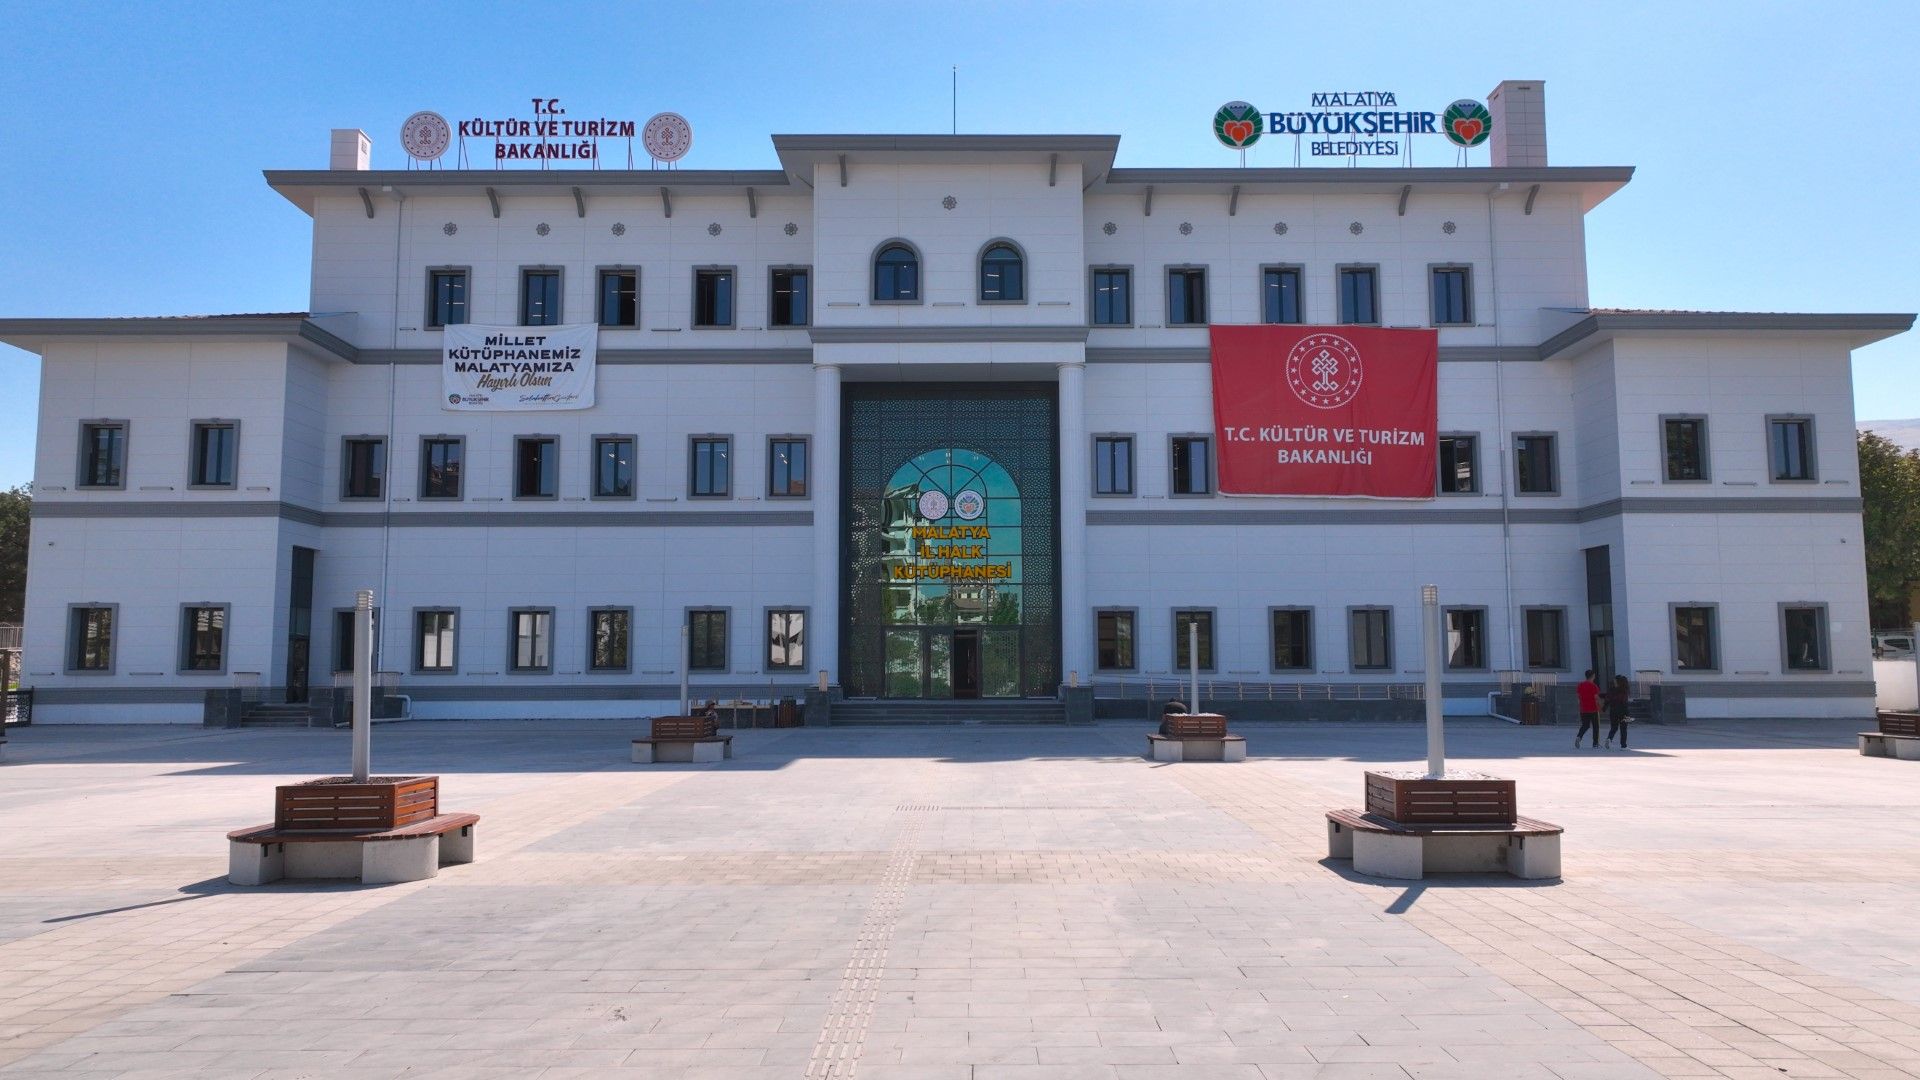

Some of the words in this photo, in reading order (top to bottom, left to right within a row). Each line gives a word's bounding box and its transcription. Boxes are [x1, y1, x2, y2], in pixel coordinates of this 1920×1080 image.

[532, 98, 565, 114] T.C.
[1311, 92, 1397, 107] MALATYA
[458, 119, 530, 137] KÜLTÜR
[535, 121, 558, 137] VE
[563, 117, 635, 137] TURİZM
[495, 140, 597, 159] BAKANLIĞI
[1311, 141, 1398, 156] BELEDİYESİ
[485, 333, 546, 346] MİLLET
[448, 346, 581, 360] KÜTÜPHANEMİZ
[454, 362, 574, 373] MALATYAMIZA
[476, 373, 517, 392] Hayırlı
[519, 371, 552, 387] Olsun
[1224, 427, 1255, 441] T.C.
[1259, 425, 1328, 442] KÜLTÜR
[1333, 428, 1354, 443] VE
[1358, 428, 1425, 446] TURİZM
[1278, 448, 1372, 465] BAKANLIĞI
[912, 526, 990, 539] MALATYA
[920, 544, 935, 559] İL
[938, 545, 983, 559] HALK
[894, 562, 1012, 578] KÜTÜPHANESİ
